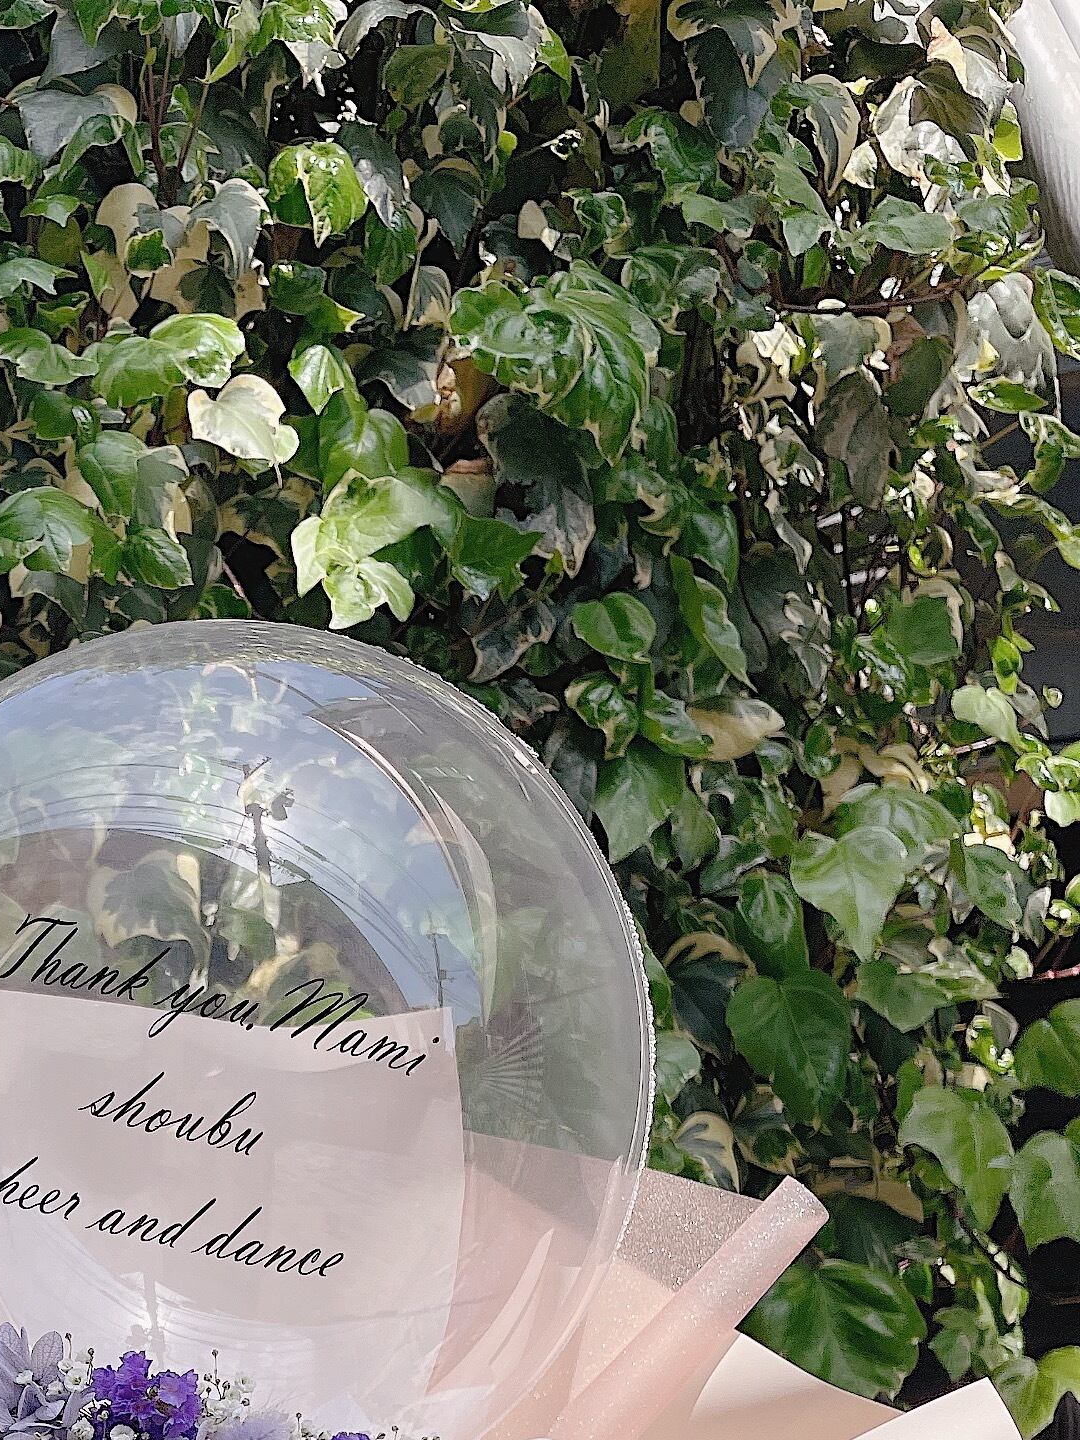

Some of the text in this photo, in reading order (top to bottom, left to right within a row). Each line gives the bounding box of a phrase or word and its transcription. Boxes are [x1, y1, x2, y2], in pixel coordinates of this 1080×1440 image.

[269, 978, 442, 1077] Mami
[78, 1071, 264, 1156] shoubu
[85, 1198, 218, 1249] and
[191, 1207, 345, 1278] dance
